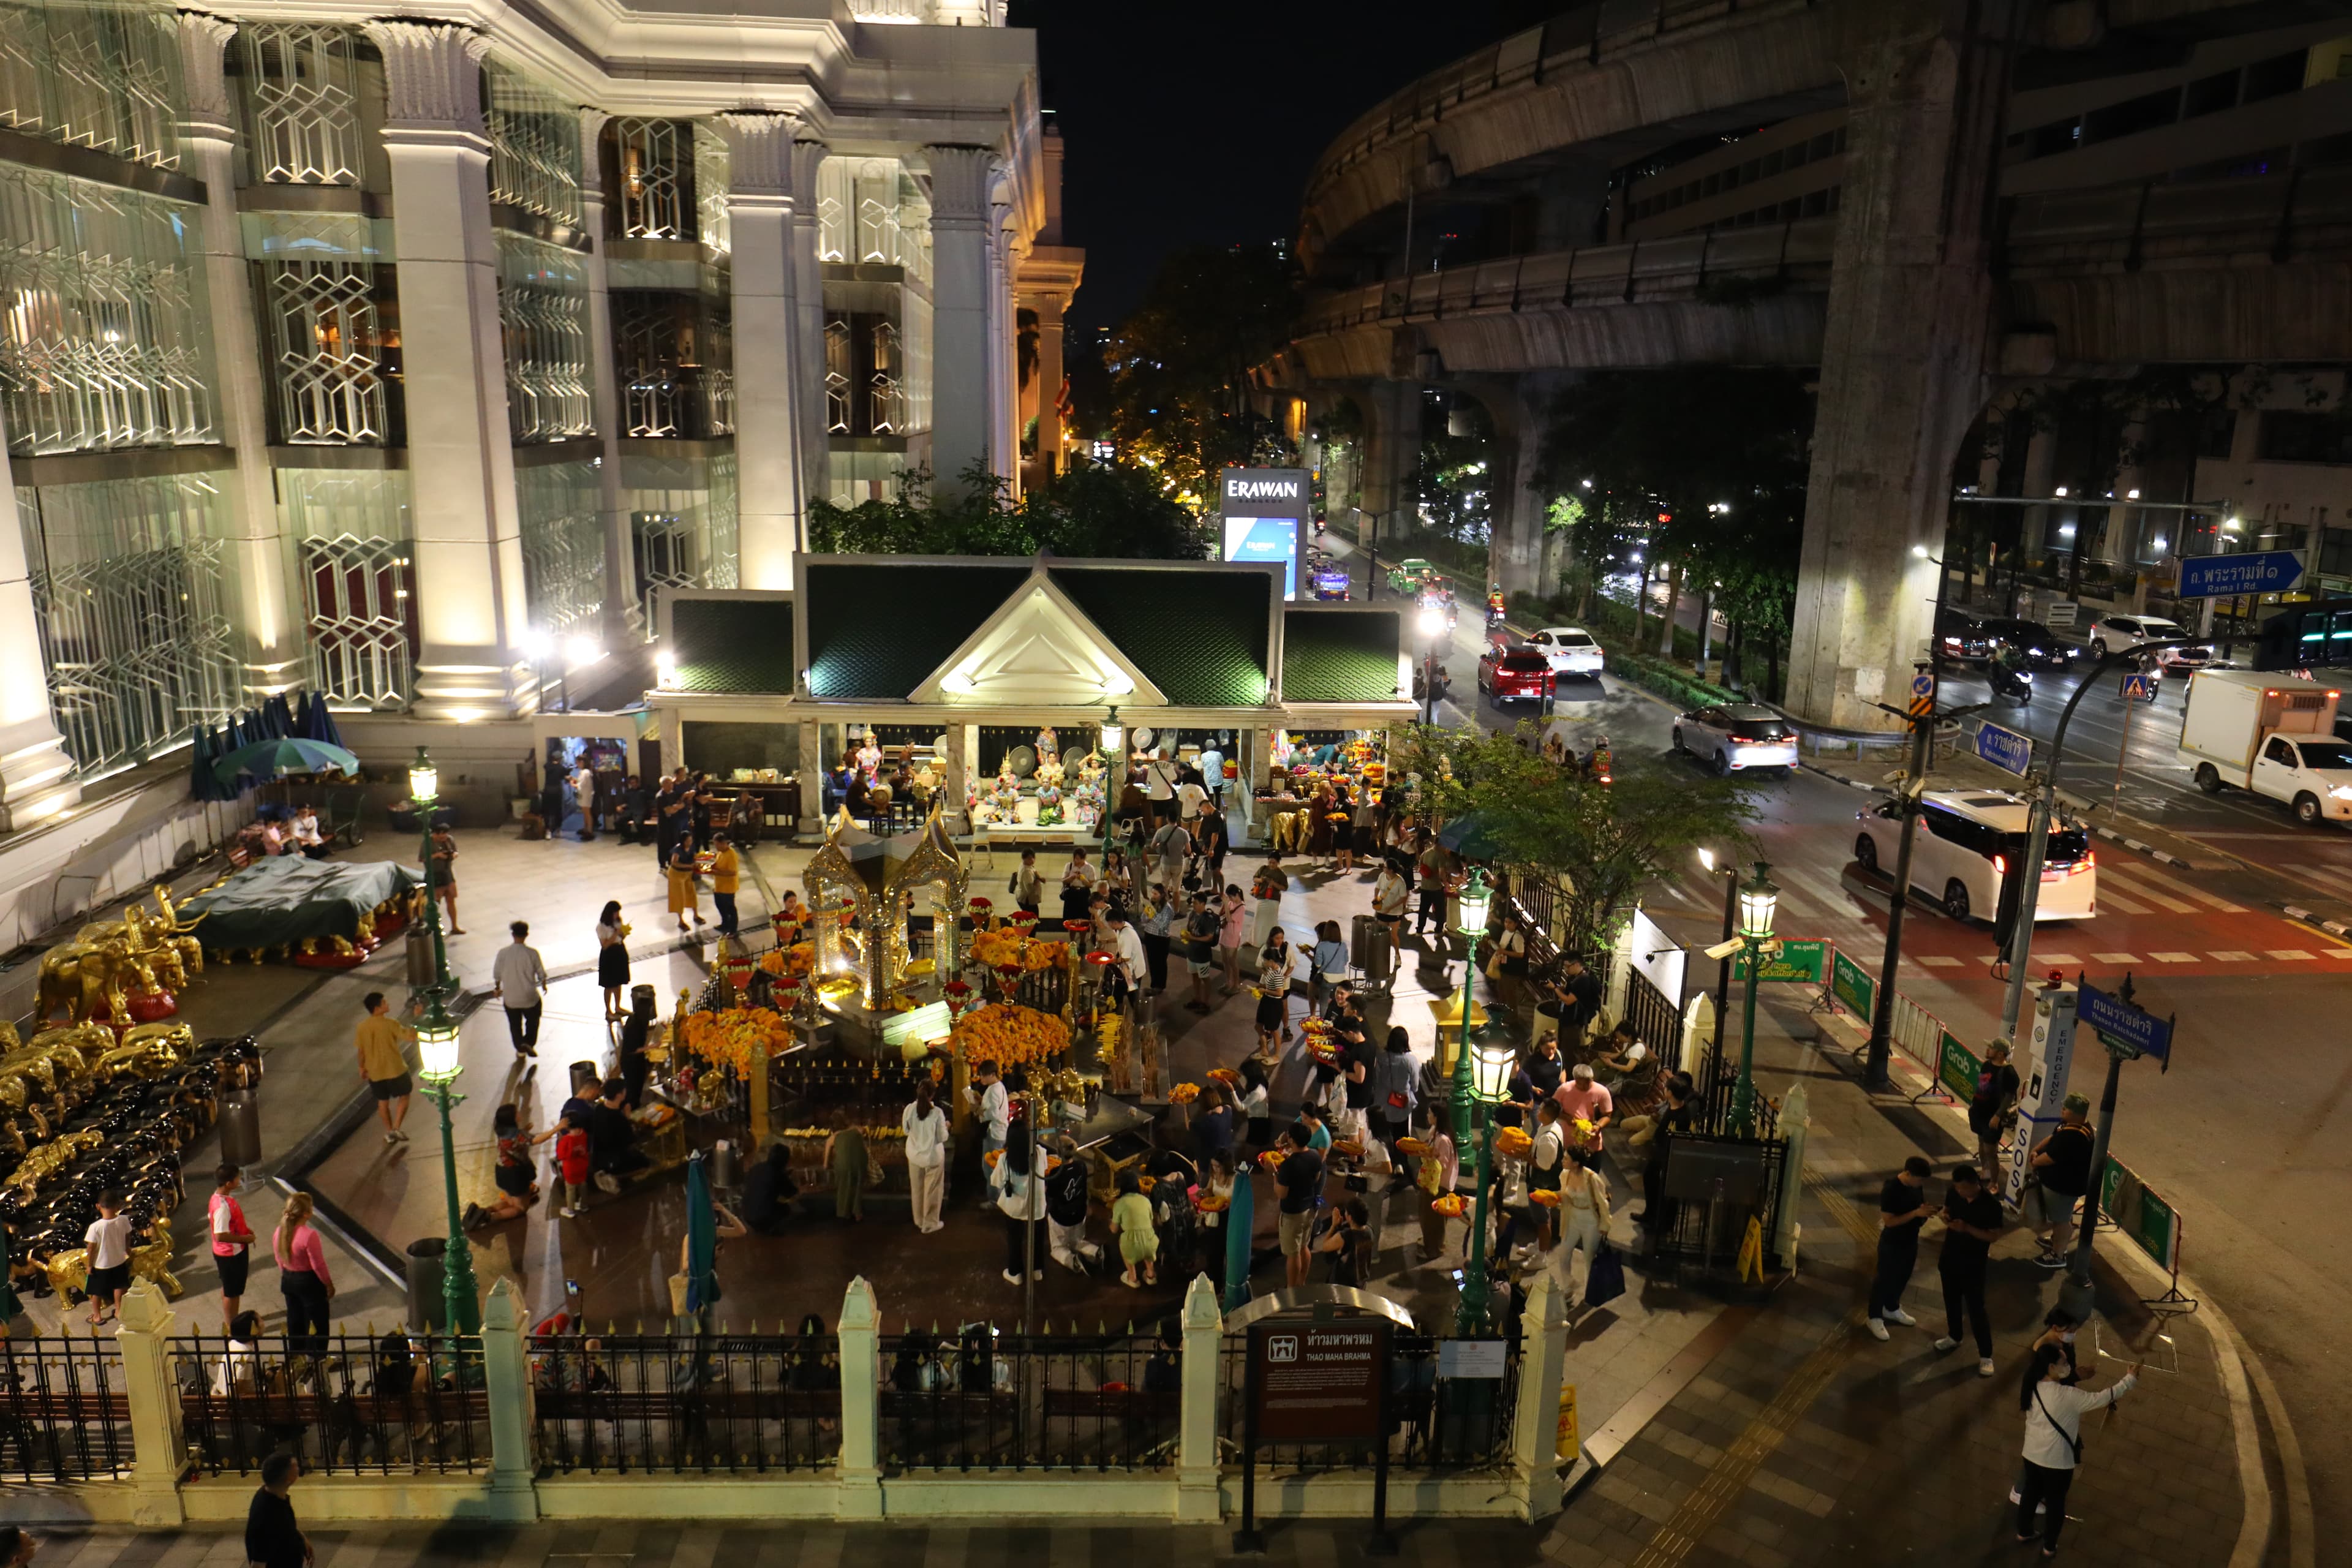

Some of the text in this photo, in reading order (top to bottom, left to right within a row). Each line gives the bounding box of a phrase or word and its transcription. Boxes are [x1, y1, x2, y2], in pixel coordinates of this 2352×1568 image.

[1227, 480, 1298, 499] ERAWAN
[2207, 584, 2234, 594] Rama
[2243, 582, 2258, 591] Rd.
[1837, 960, 1855, 985] Grab
[2008, 1024, 2016, 1035] 8
[2091, 1011, 2150, 1046] Thanon Ratchadamri
[2092, 998, 2152, 1036] ถนนราชดำริ
[1947, 1044, 1970, 1074] Grab
[2049, 1029, 2068, 1106] EMERGENCY
[2010, 1128, 2028, 1189] SOS
[1306, 1329, 1373, 1346] ท้าวมหาพรหม
[1306, 1352, 1371, 1362] THAO MAHA BRAHMA
